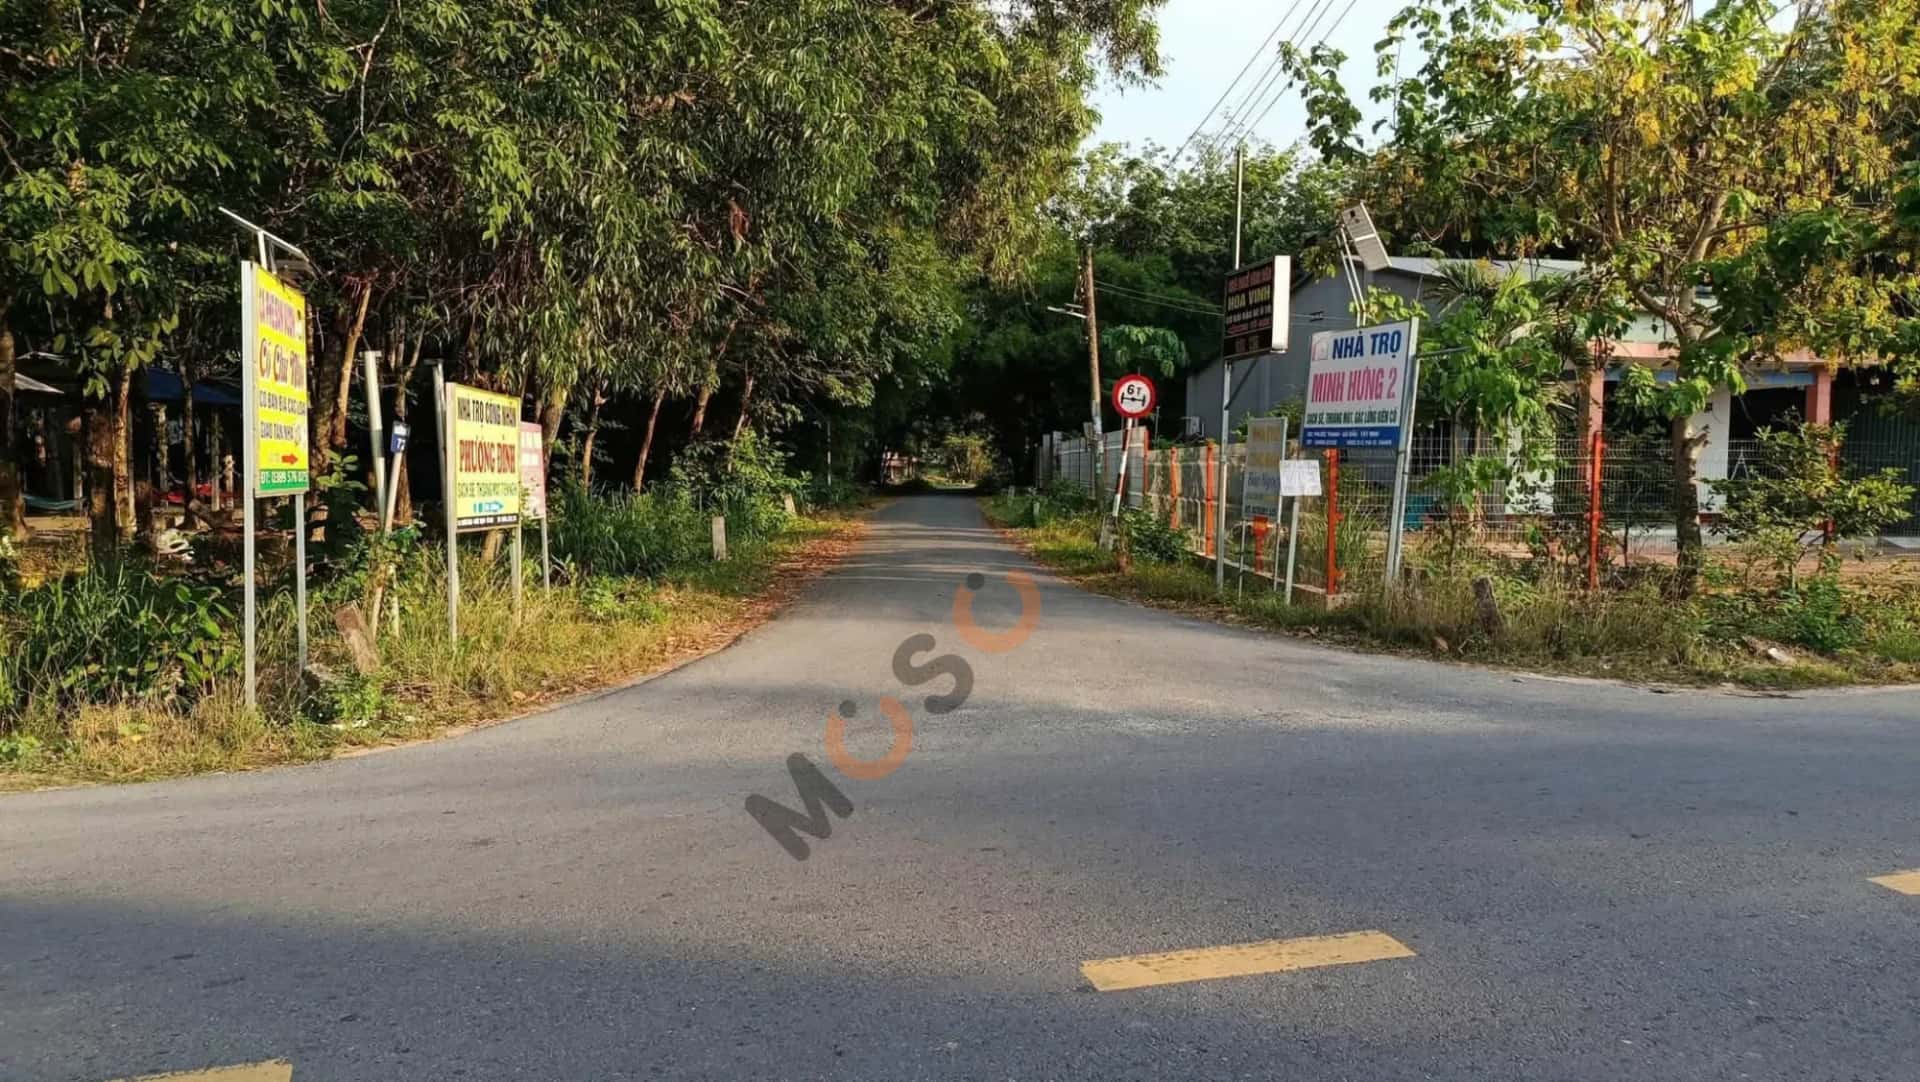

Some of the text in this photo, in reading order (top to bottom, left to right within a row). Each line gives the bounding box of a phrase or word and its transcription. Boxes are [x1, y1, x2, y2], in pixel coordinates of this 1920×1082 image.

[1248, 284, 1271, 305] VINH
[1332, 329, 1402, 360] NHÀ TRỌ
[1127, 384, 1142, 397] 6T
[1311, 371, 1345, 403] MINH
[1387, 367, 1398, 399] 2
[472, 400, 484, 428] TRỌ
